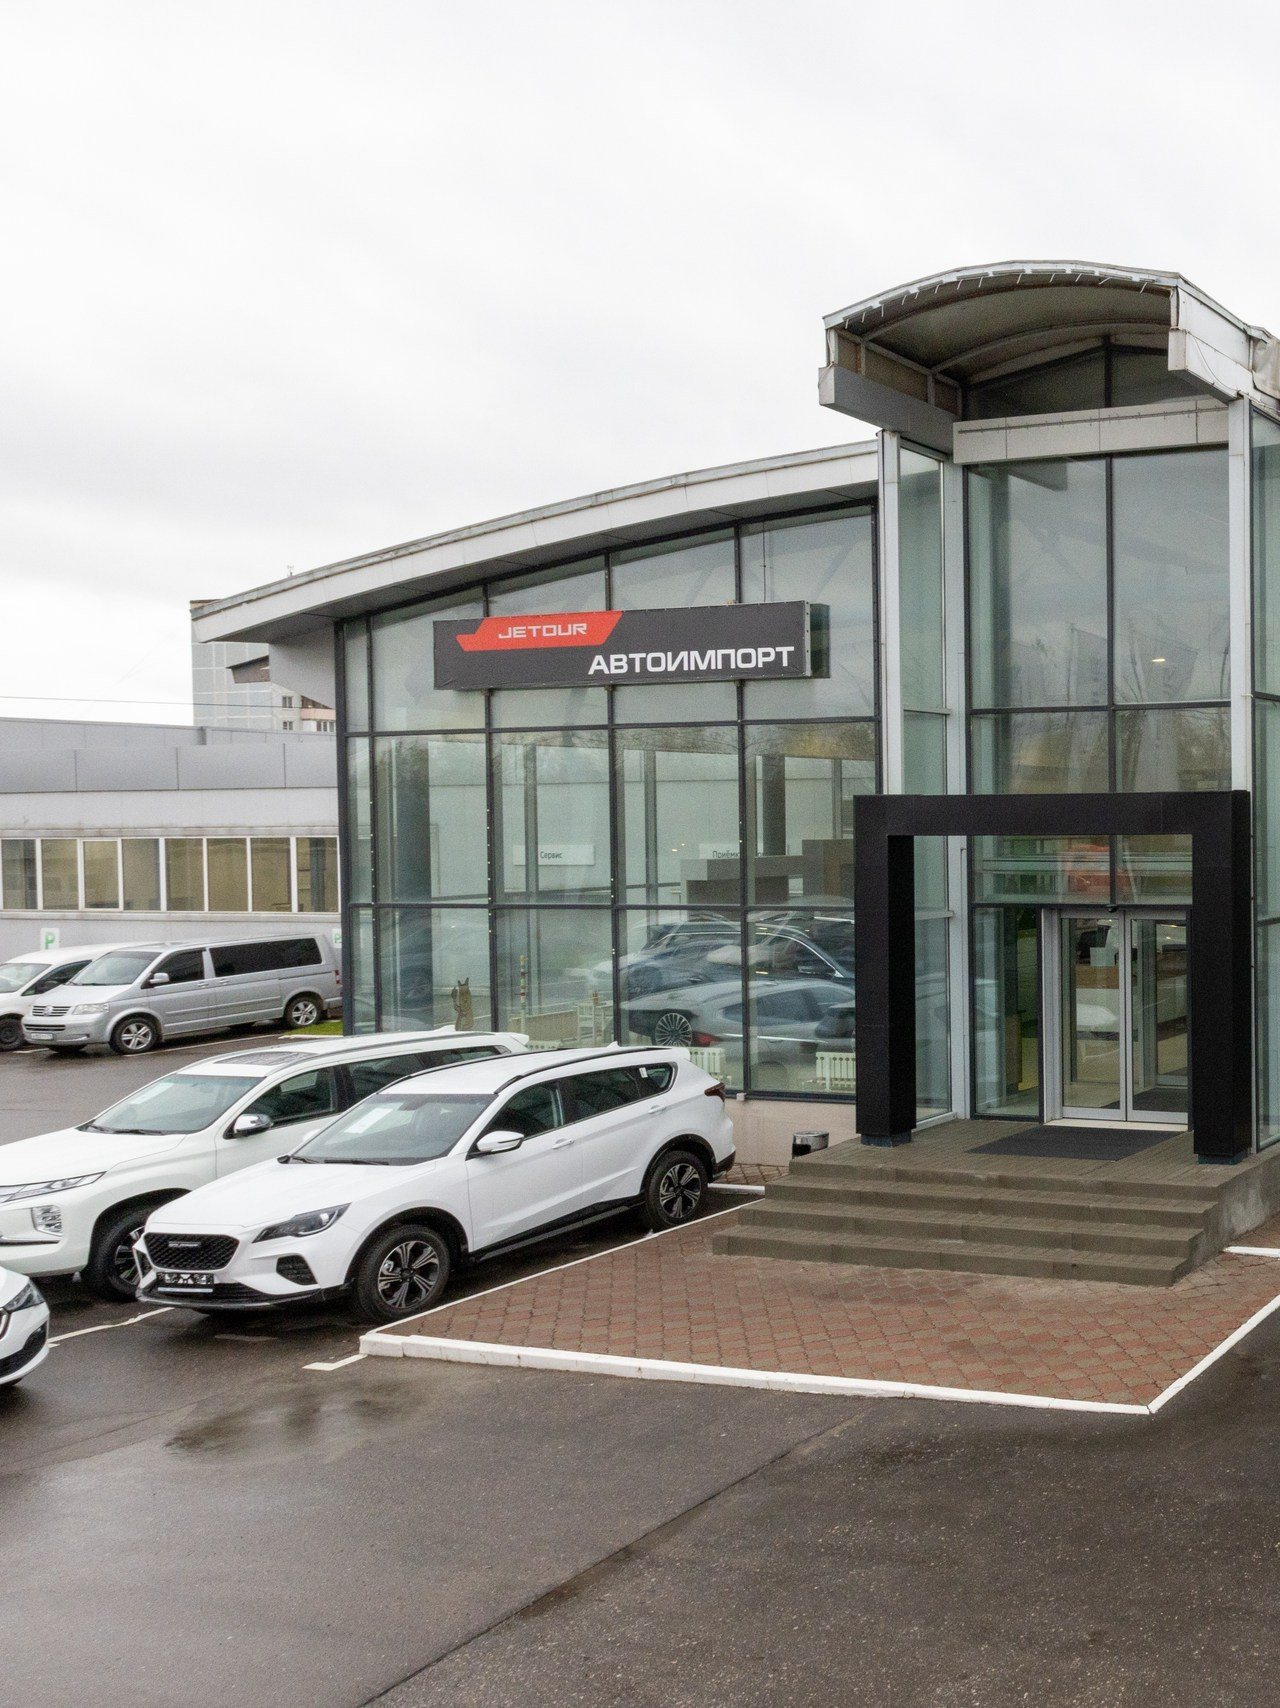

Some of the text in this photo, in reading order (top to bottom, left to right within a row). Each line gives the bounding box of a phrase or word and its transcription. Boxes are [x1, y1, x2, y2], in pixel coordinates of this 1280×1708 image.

[498, 623, 588, 639] JETOUR
[588, 646, 795, 675] АВТОИМПОРТ
[539, 850, 563, 860] Сервис
